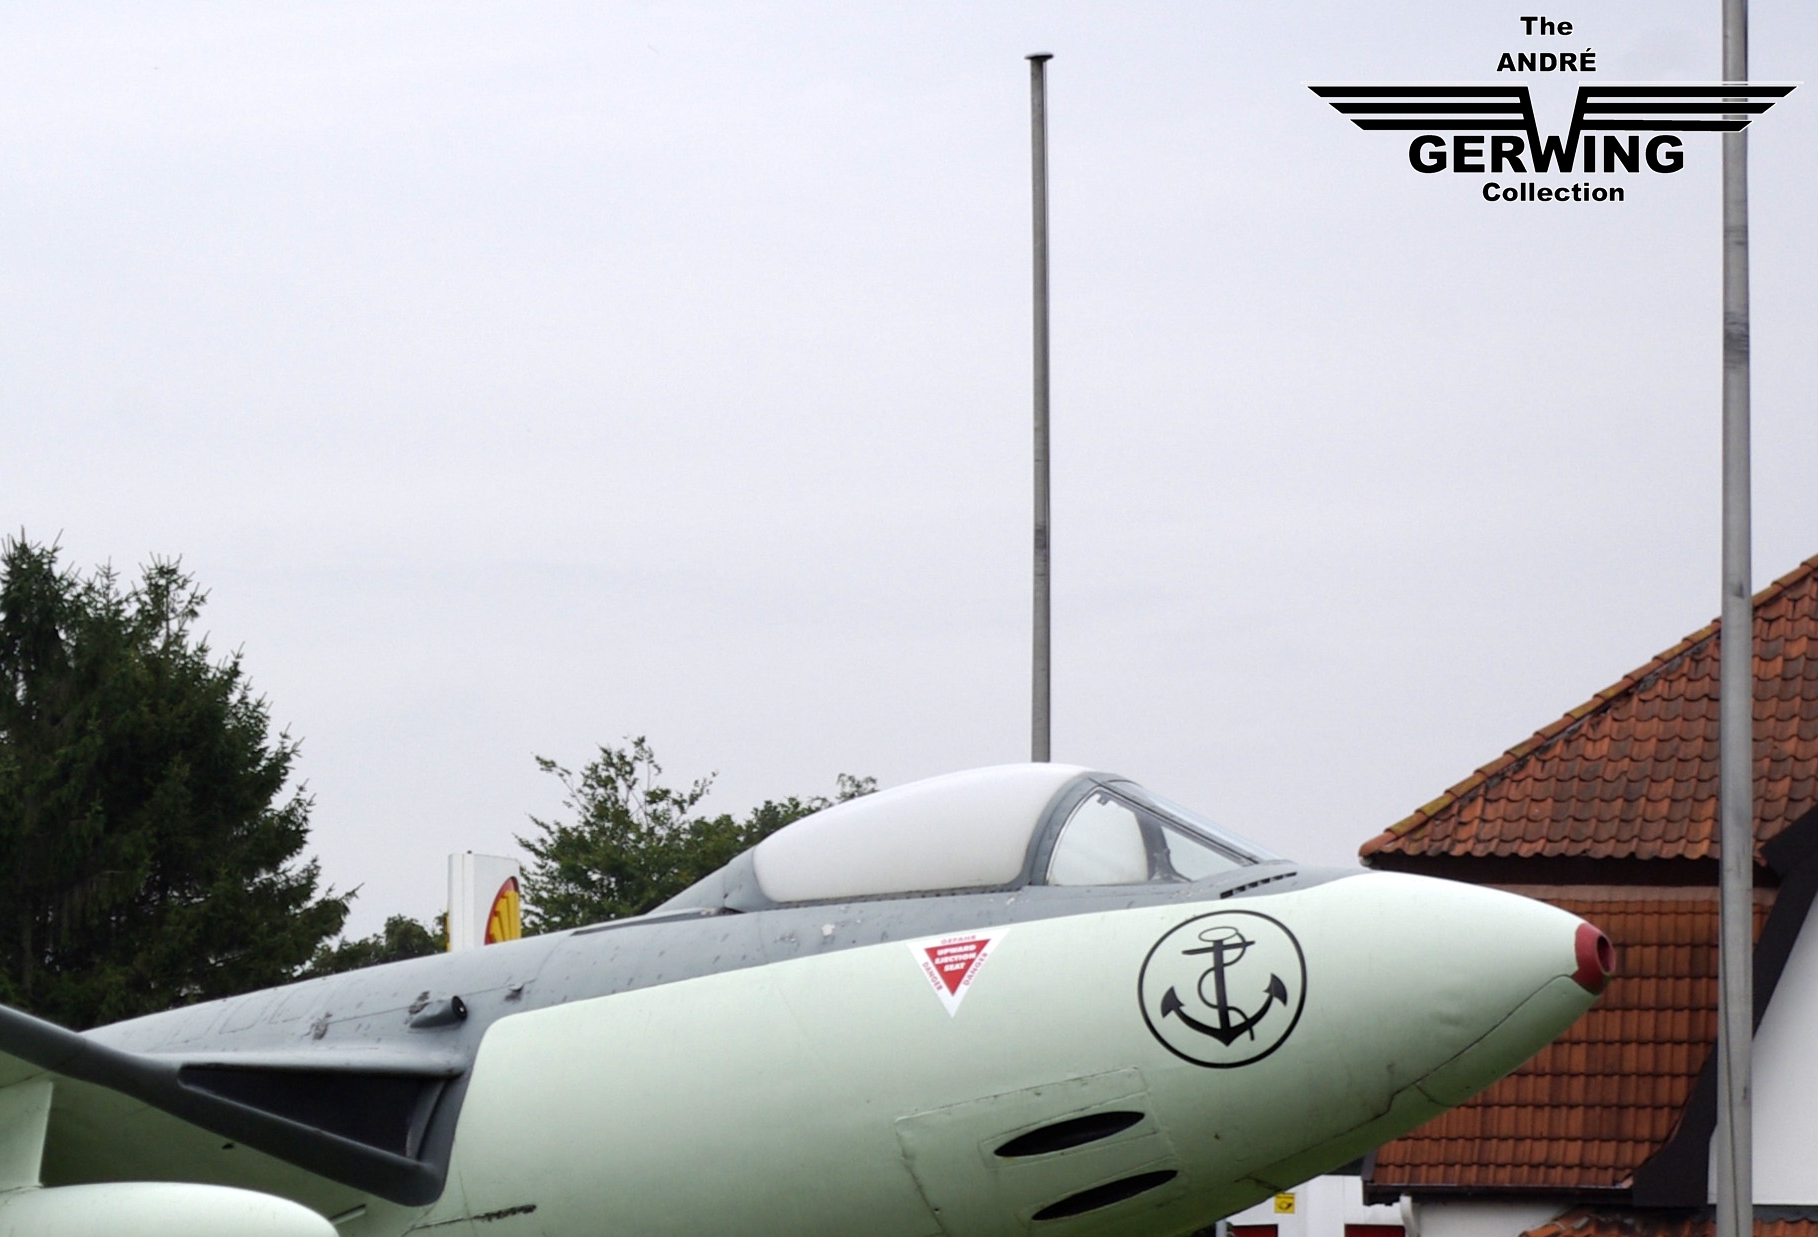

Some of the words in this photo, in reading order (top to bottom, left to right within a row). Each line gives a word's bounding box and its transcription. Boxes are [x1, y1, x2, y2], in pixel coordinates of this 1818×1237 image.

[937, 944, 977, 956] UPWARD
[934, 952, 977, 965] EJECTION
[943, 962, 966, 972] SEAT
[963, 952, 988, 986] DANGER
[922, 961, 943, 991] DANGER
